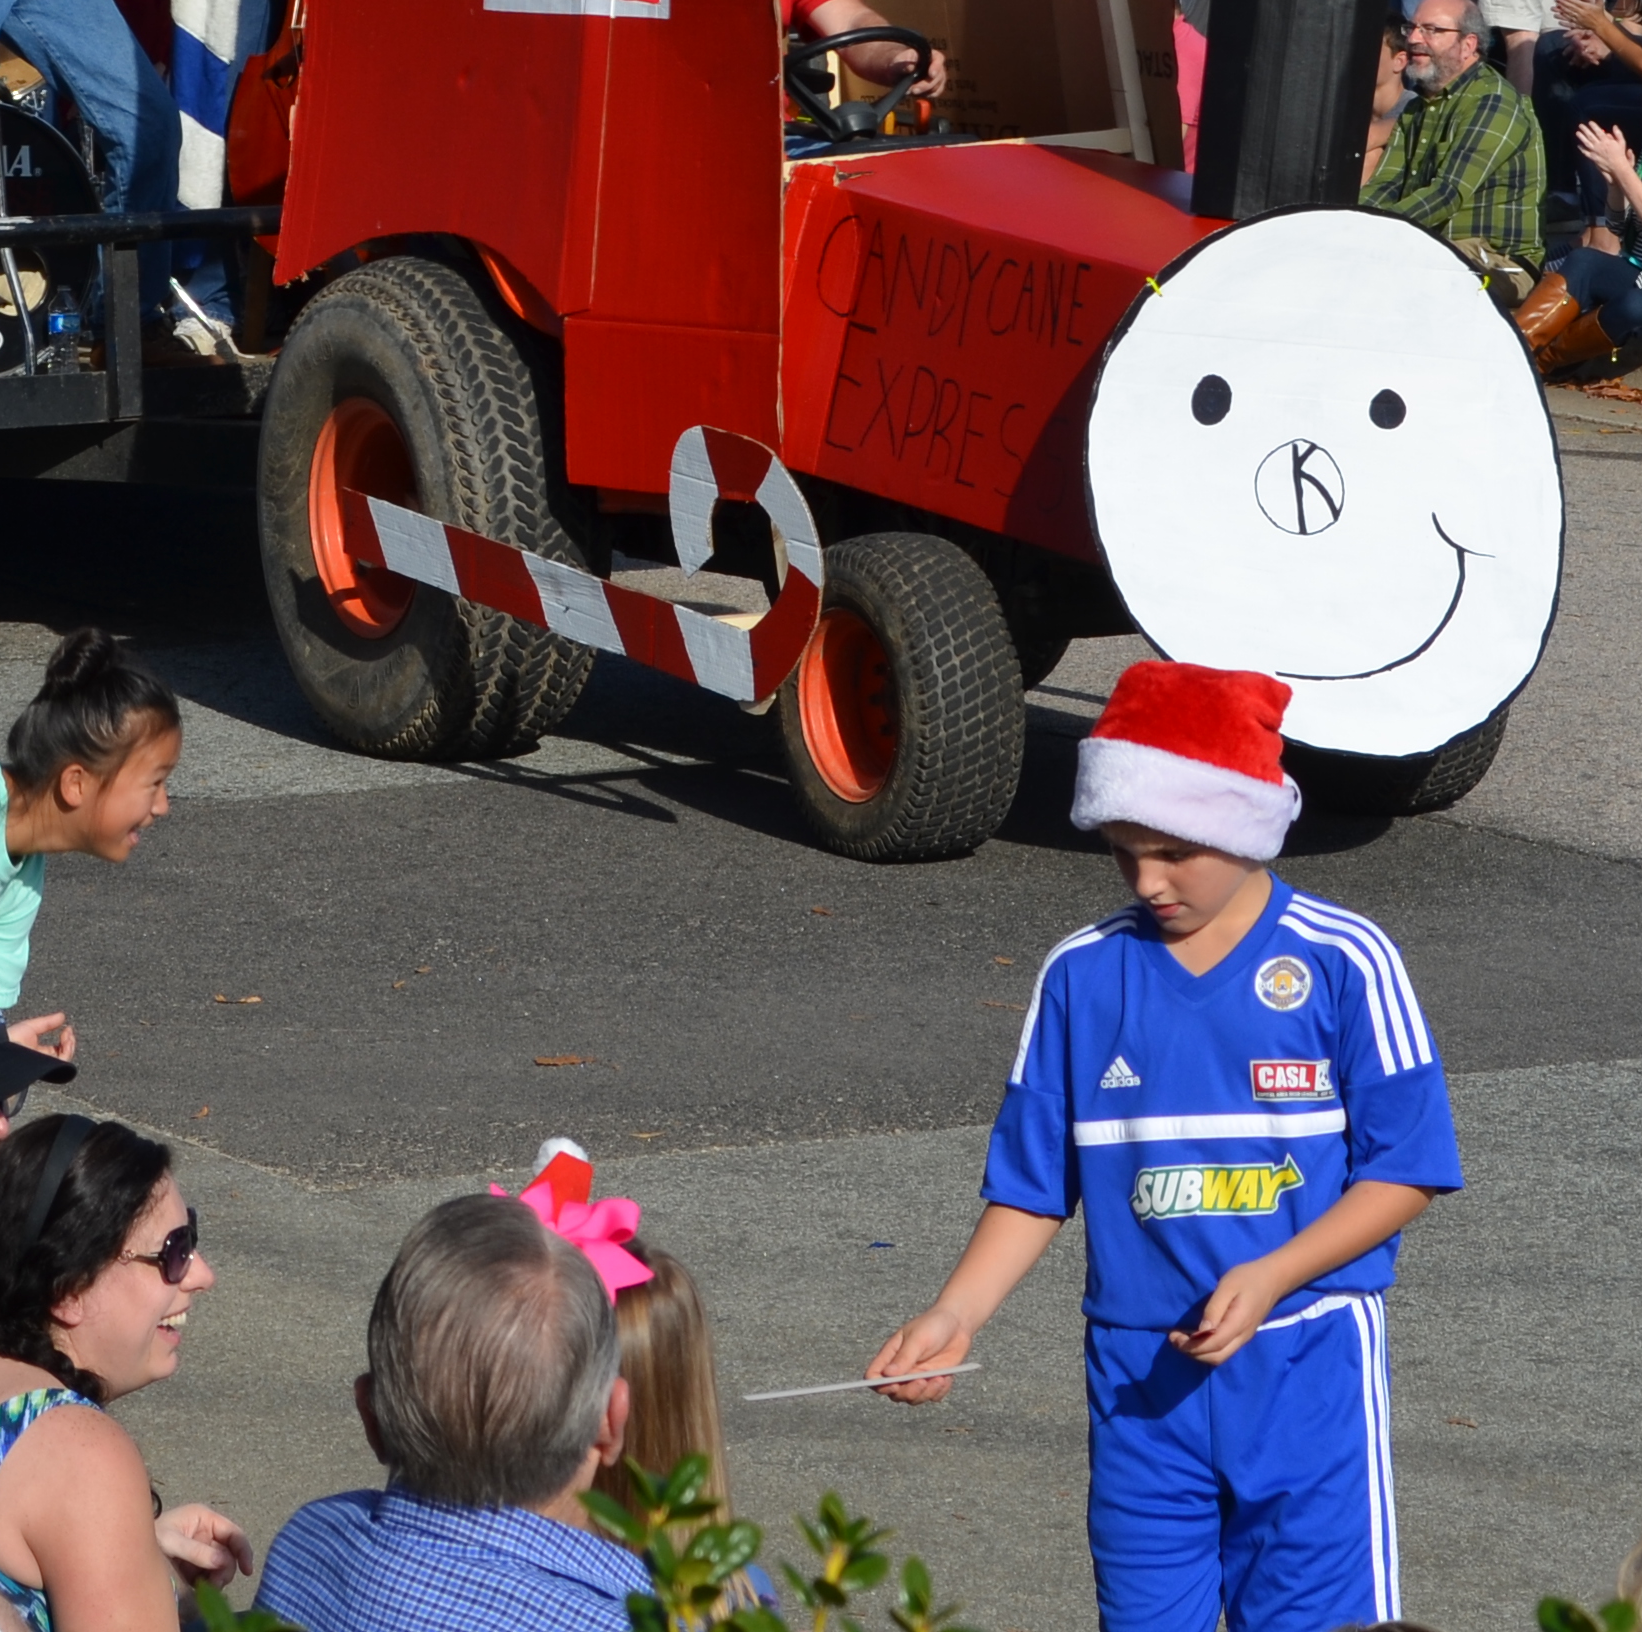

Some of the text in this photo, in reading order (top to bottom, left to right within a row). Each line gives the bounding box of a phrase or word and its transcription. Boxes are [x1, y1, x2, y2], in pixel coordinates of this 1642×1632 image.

[1100, 1075, 1141, 1089] adidas
[1258, 1066, 1311, 1089] CASL
[1132, 1167, 1298, 1215] SUBWAY
